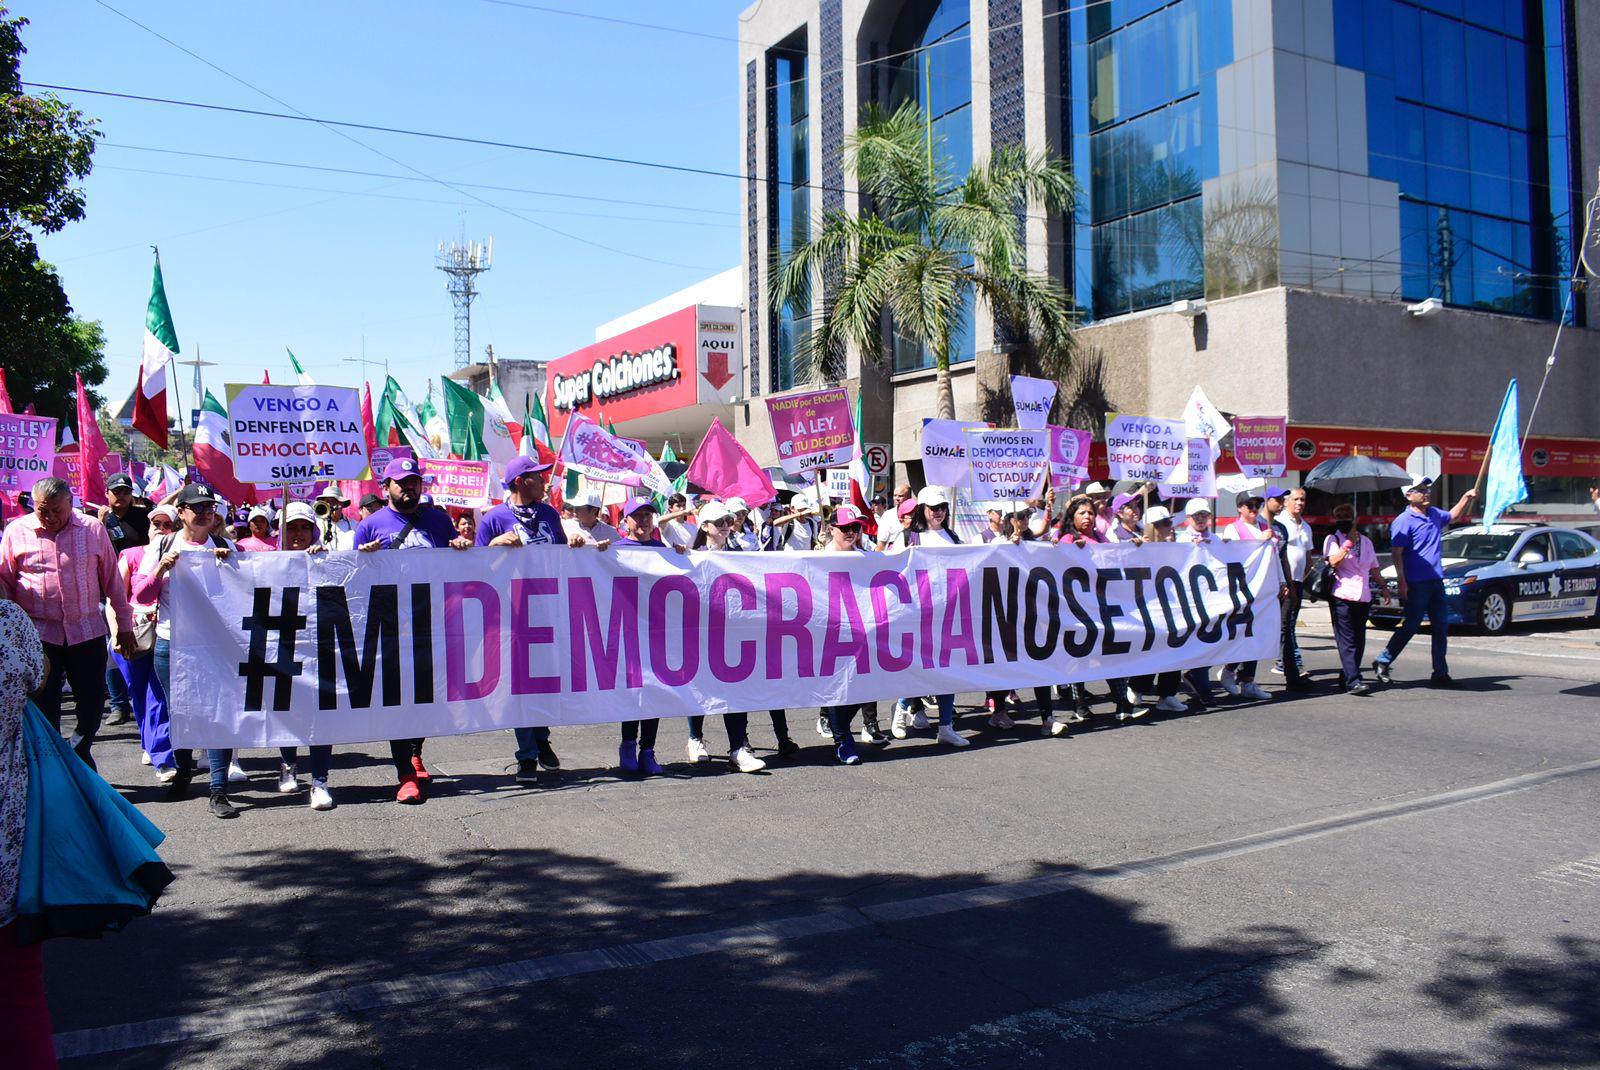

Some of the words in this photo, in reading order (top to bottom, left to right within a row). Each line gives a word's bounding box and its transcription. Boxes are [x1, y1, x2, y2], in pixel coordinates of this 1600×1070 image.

[702, 339, 734, 350] AQUI
[553, 373, 592, 409] Super
[253, 398, 320, 412] VENGO
[327, 398, 339, 412] A
[772, 399, 798, 412] NADIE
[800, 400, 812, 409] por
[814, 393, 845, 405] ENCIMA
[7, 423, 17, 432] la
[20, 420, 50, 438] LEY
[235, 420, 336, 433] DENFENDER
[340, 422, 358, 433] LA
[790, 422, 807, 437] LA
[810, 416, 836, 434] LEY.
[1121, 423, 1161, 434] VENGO
[1164, 426, 1172, 435] A
[812, 433, 852, 449] DECIDE!
[982, 436, 1018, 445] VIVIMOS
[1022, 437, 1034, 445] EN
[1108, 438, 1168, 450] DENFENDER
[1171, 442, 1184, 450] LA
[237, 442, 362, 456] DEMOCRACIA
[972, 448, 1046, 458] DEMOCRACIA
[985, 461, 1028, 469] QUEREMOS
[1110, 453, 1183, 466] DEMOCRACIA
[426, 462, 441, 471] Por
[445, 464, 458, 472] un
[437, 474, 484, 486] LIBRE!!
[442, 486, 482, 497] DECIDE!
[1564, 580, 1571, 592] DE
